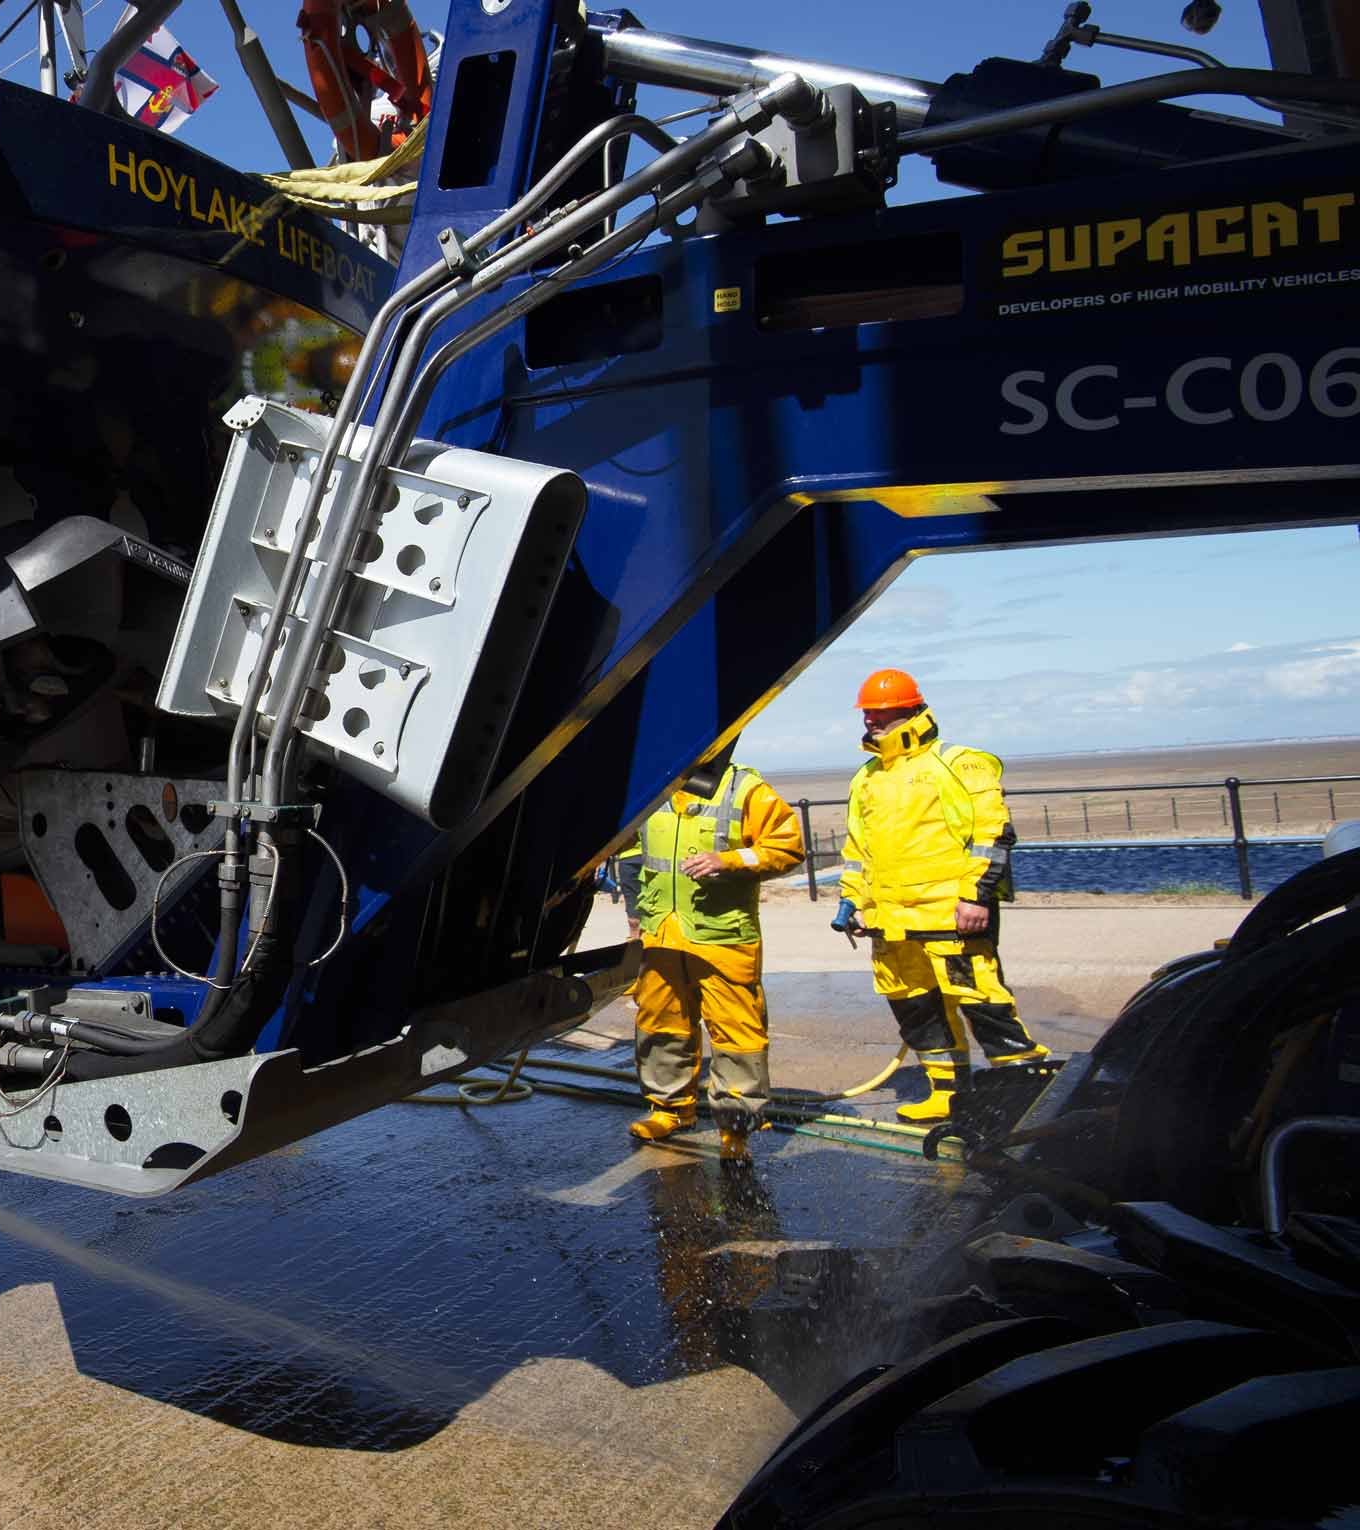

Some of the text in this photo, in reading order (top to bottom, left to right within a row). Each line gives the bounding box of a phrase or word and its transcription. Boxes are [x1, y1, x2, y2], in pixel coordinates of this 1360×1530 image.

[108, 143, 376, 302] HOYLAKE LIFEBOAT
[1002, 193, 1355, 277] SUPACAT
[998, 268, 1360, 316] DEVELOPERS OF HIGH MOBILITY VEHICLES
[999, 347, 1360, 435] SC-C06
